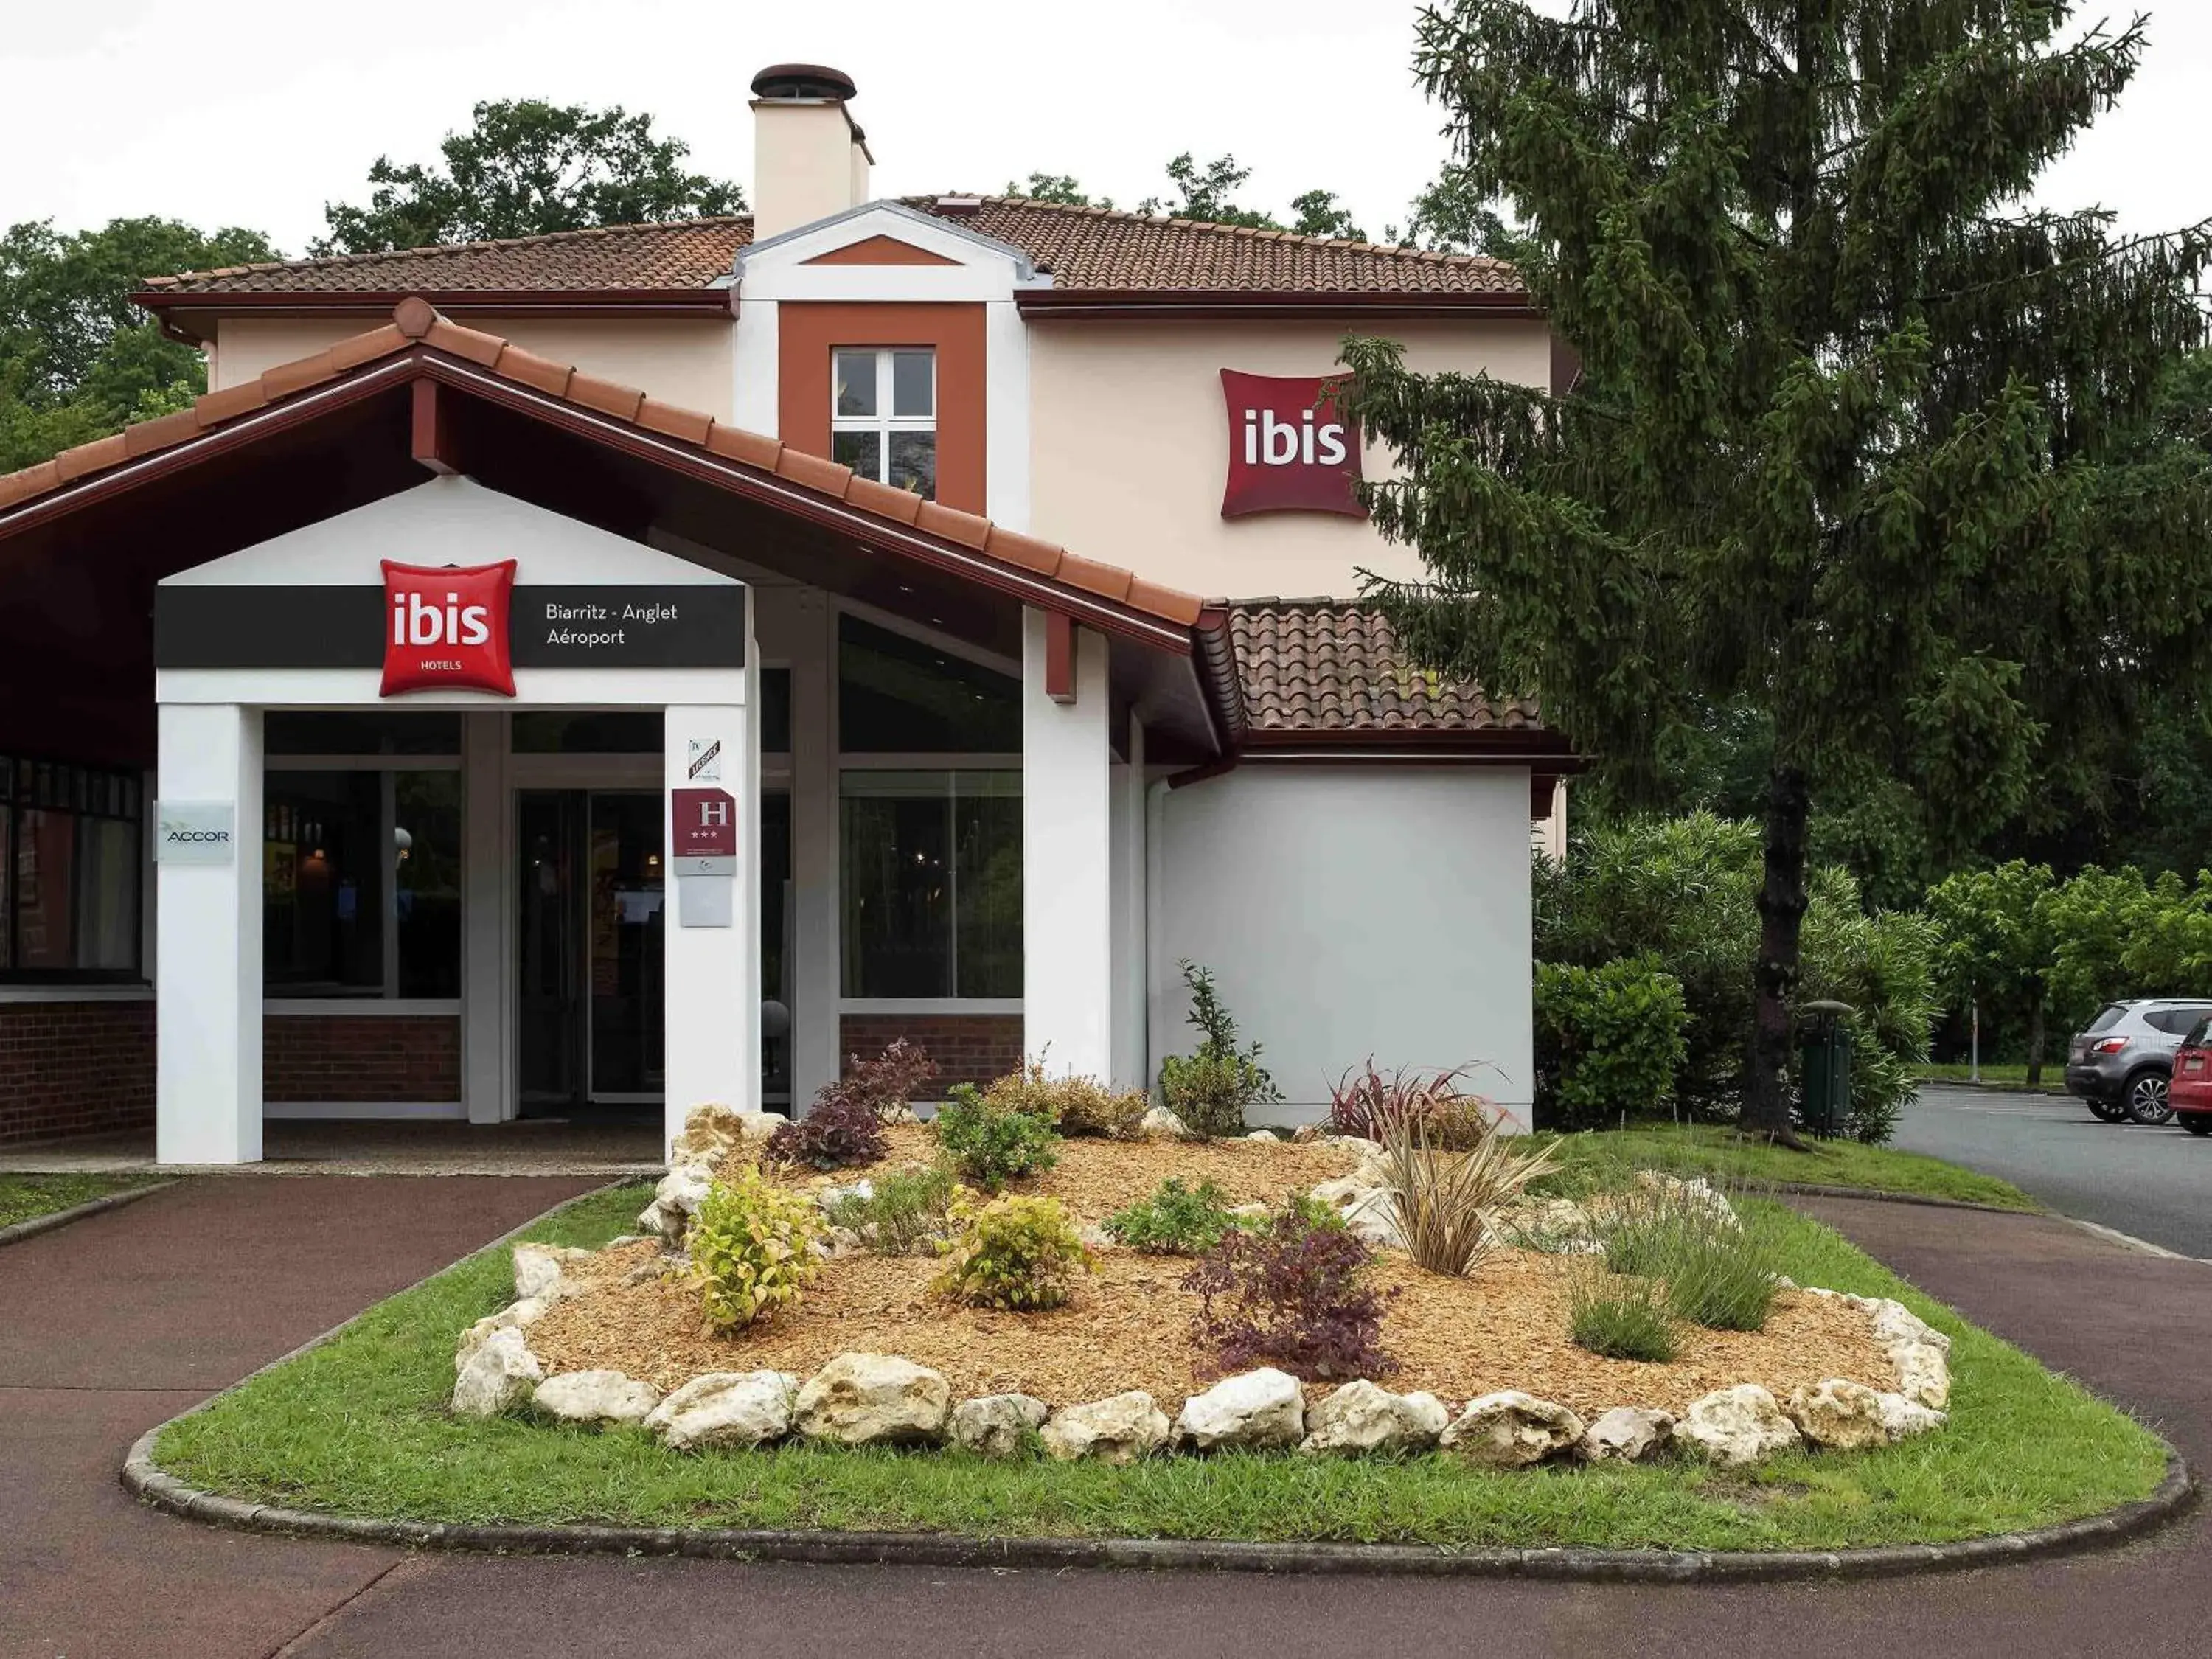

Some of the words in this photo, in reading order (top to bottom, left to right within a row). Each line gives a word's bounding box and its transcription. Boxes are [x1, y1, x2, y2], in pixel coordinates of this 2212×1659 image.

[1245, 409, 1346, 465] ibis
[394, 592, 489, 645] ibis
[546, 603, 607, 620] Biarritz
[622, 602, 678, 624] Anglet
[546, 627, 625, 648] Aéroport
[421, 661, 462, 670] HOTELS
[699, 801, 729, 827] H
[167, 831, 229, 841] ACCOR
